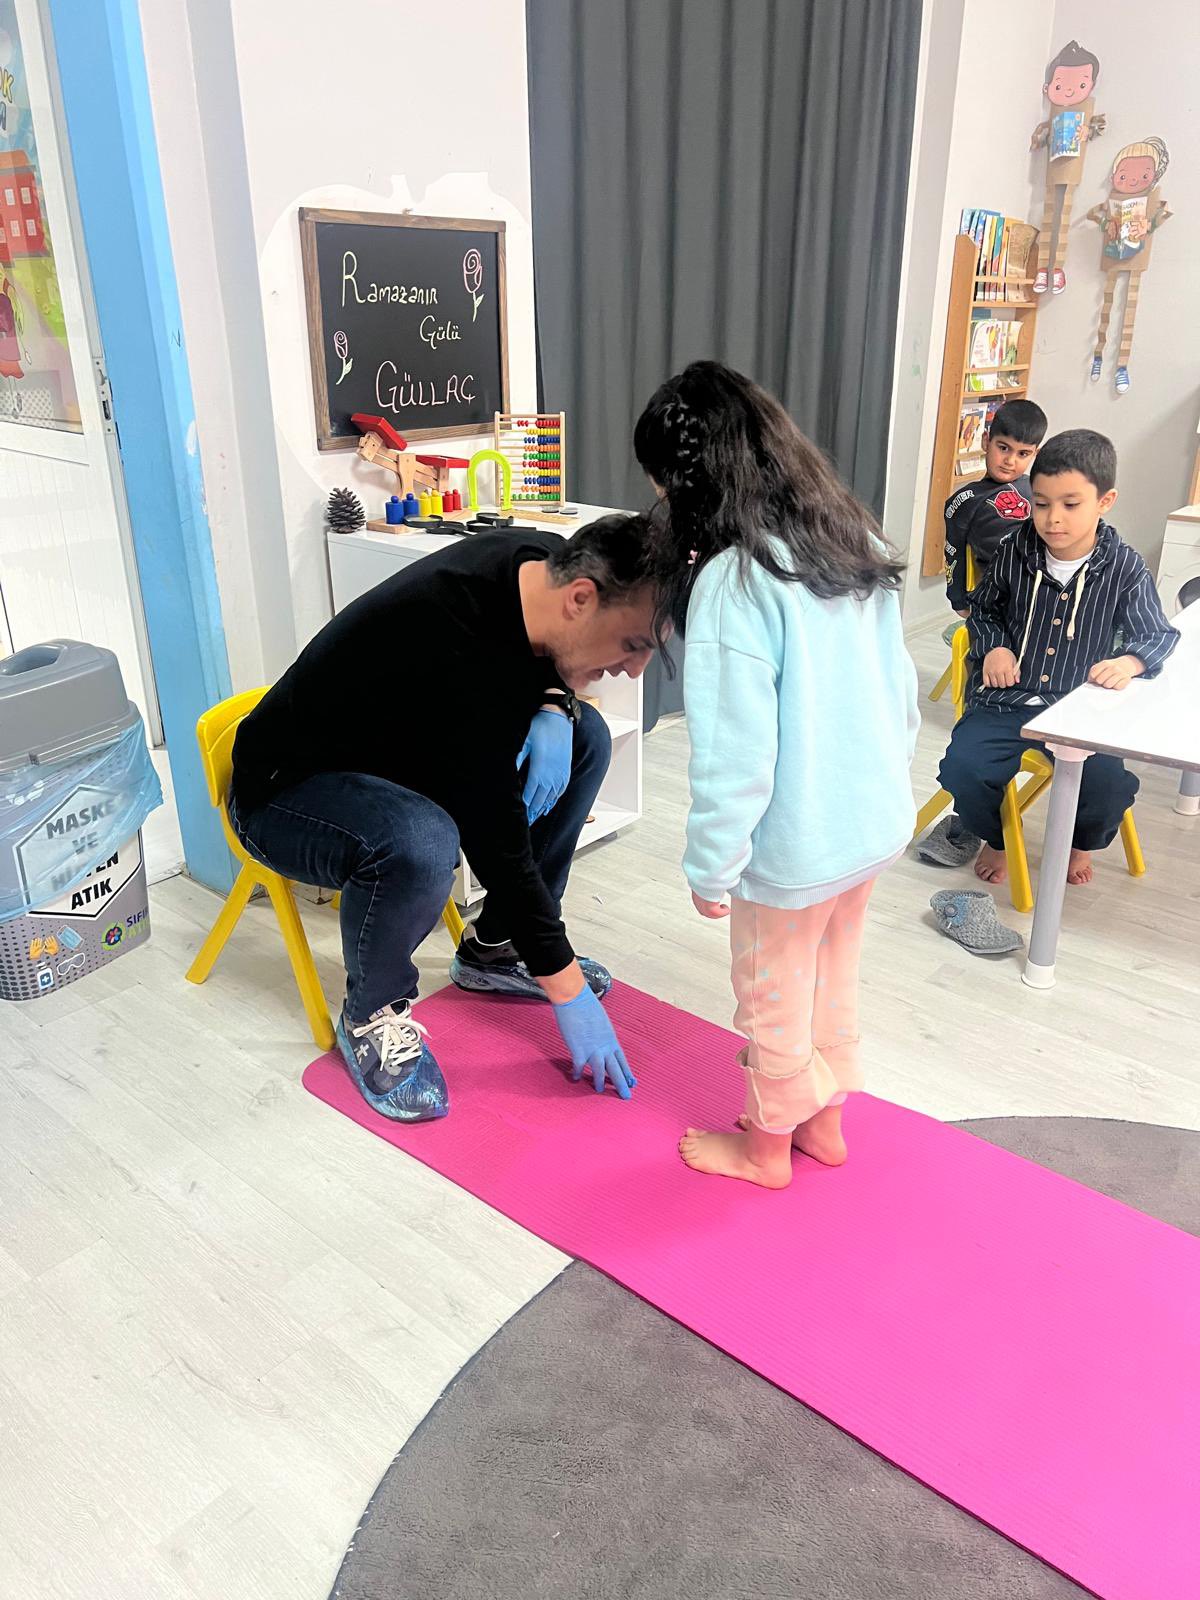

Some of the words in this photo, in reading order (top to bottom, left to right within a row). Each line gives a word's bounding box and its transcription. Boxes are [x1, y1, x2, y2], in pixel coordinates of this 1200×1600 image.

[342, 250, 438, 308] Ramazanın
[419, 315, 462, 350] Gülü
[375, 360, 476, 414] GÜLLAÇ
[45, 800, 115, 840] MASKE
[71, 831, 100, 856] VE
[71, 877, 114, 911] ATIK
